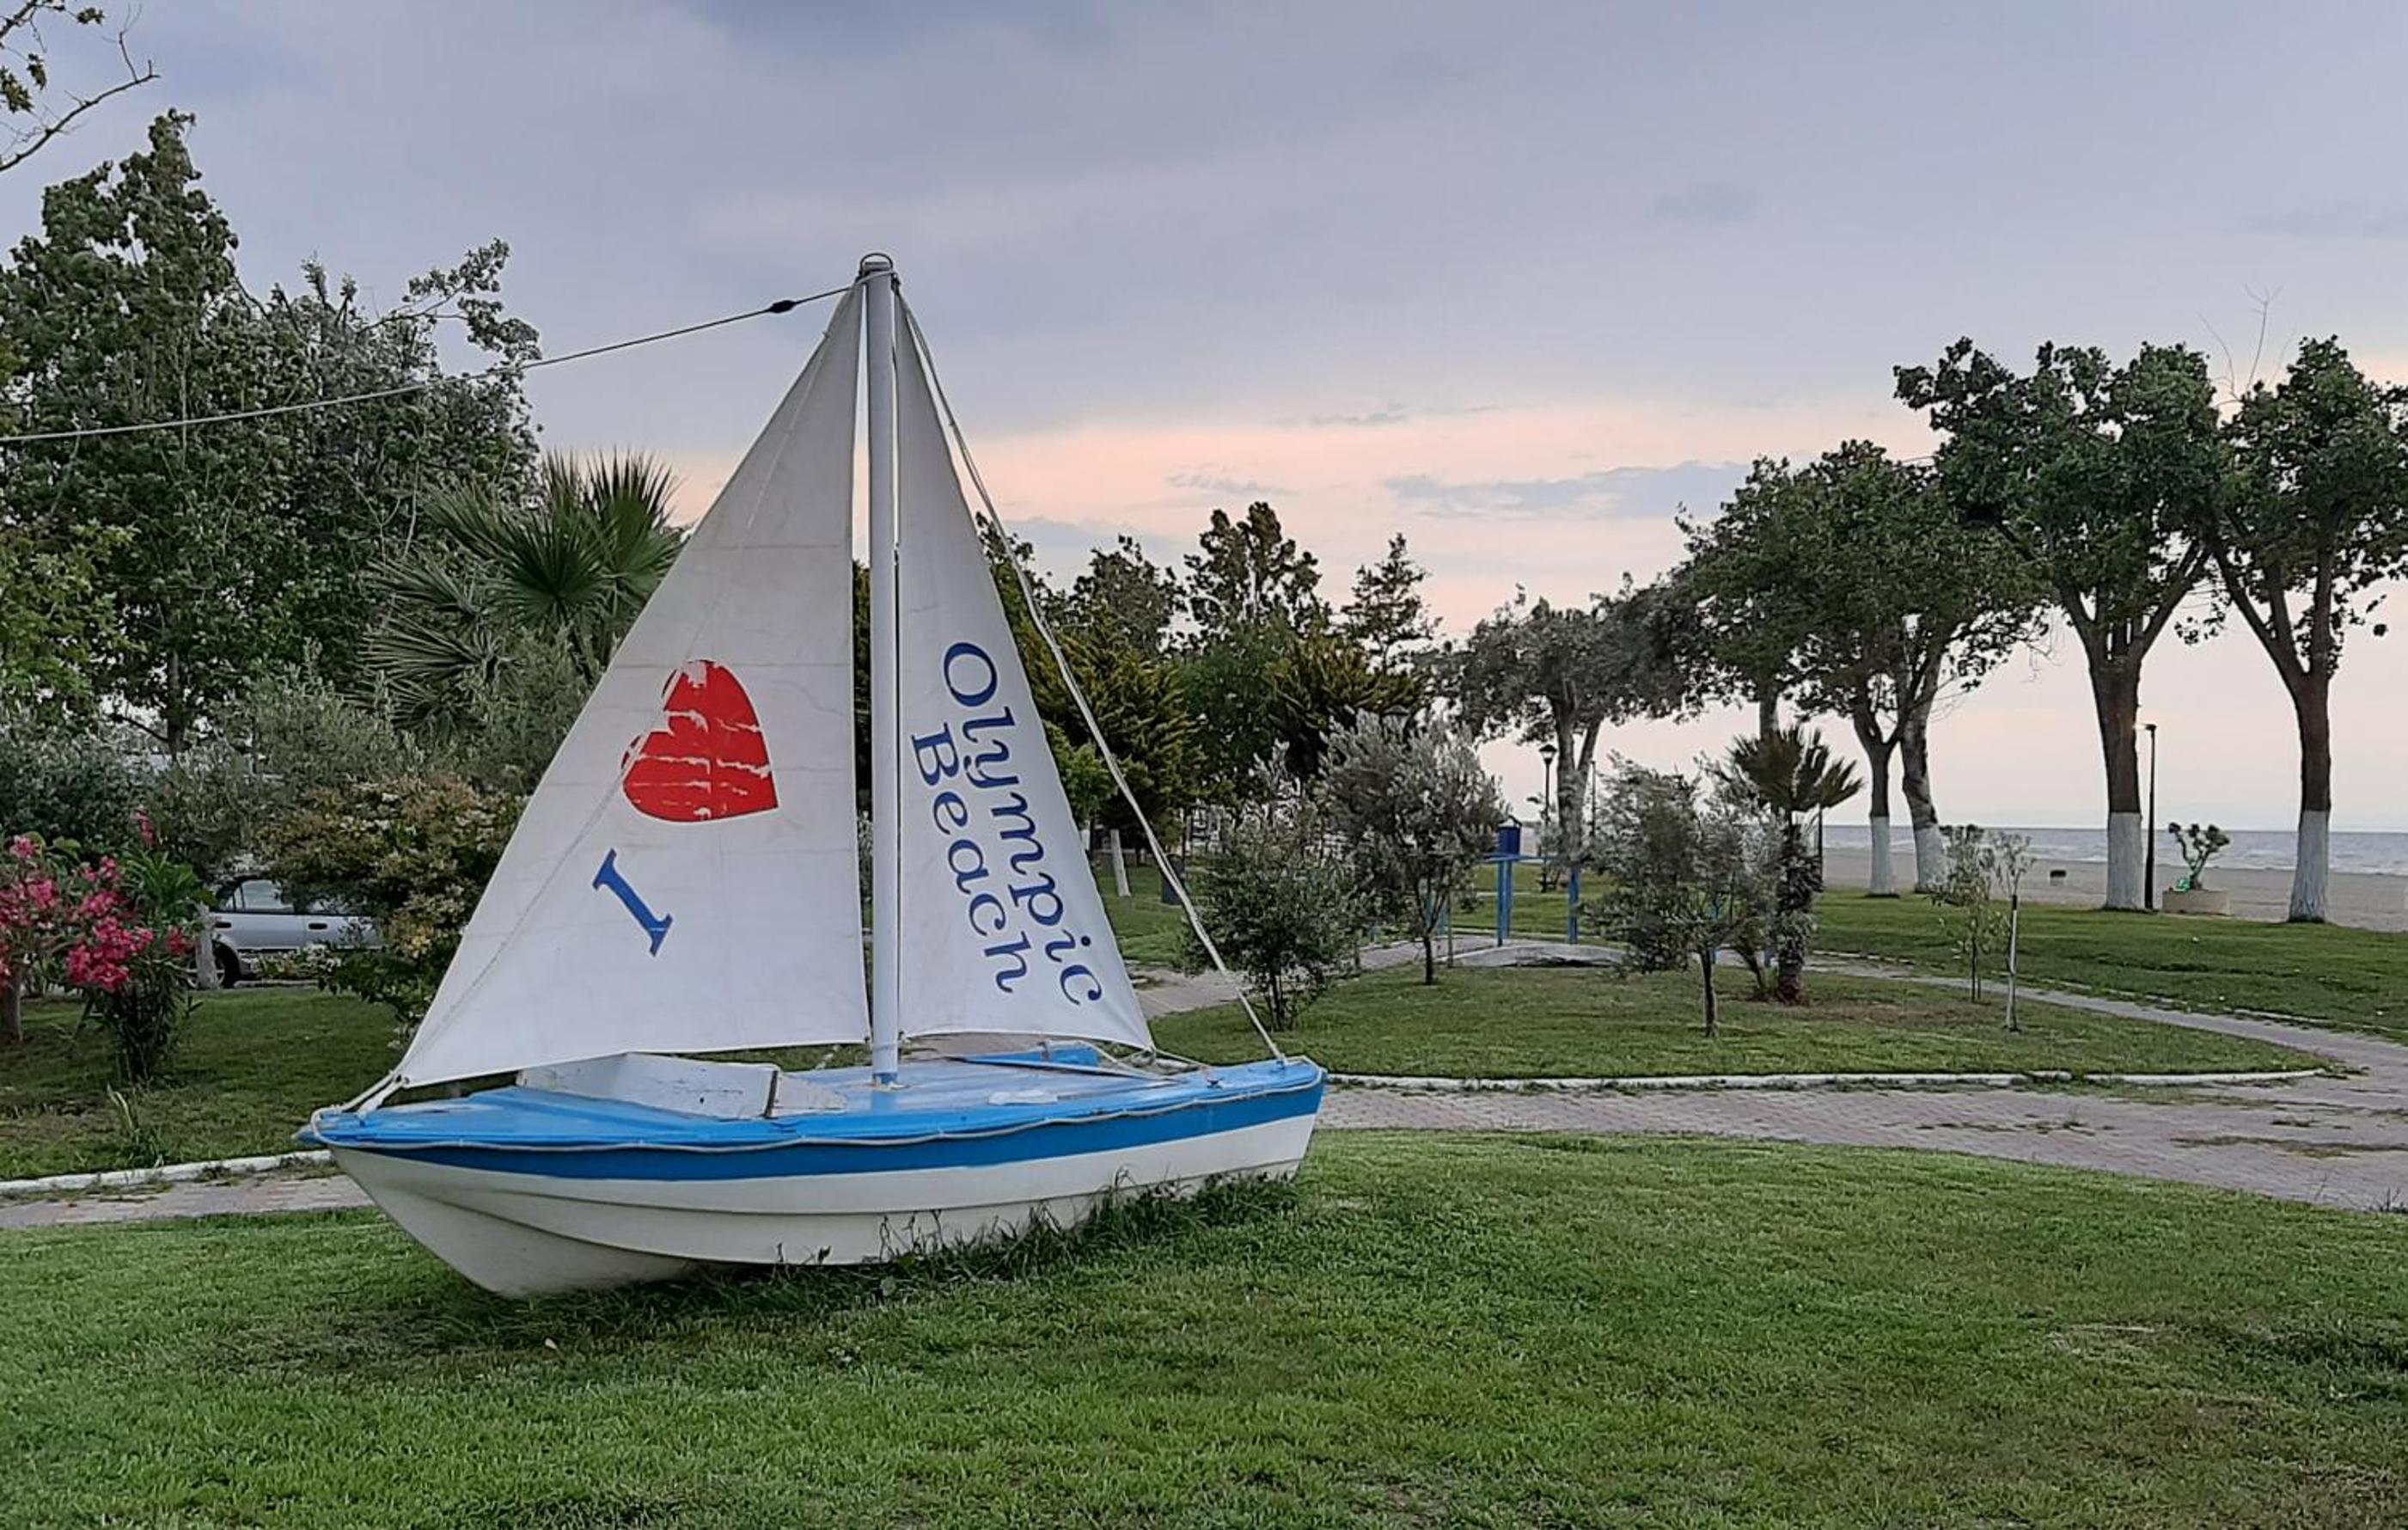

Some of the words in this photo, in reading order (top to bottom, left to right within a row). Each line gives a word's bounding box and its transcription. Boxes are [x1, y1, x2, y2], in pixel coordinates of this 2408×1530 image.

[591, 848, 674, 958] I
[911, 721, 1032, 994] Beach
[943, 641, 1103, 1006] Olympic
